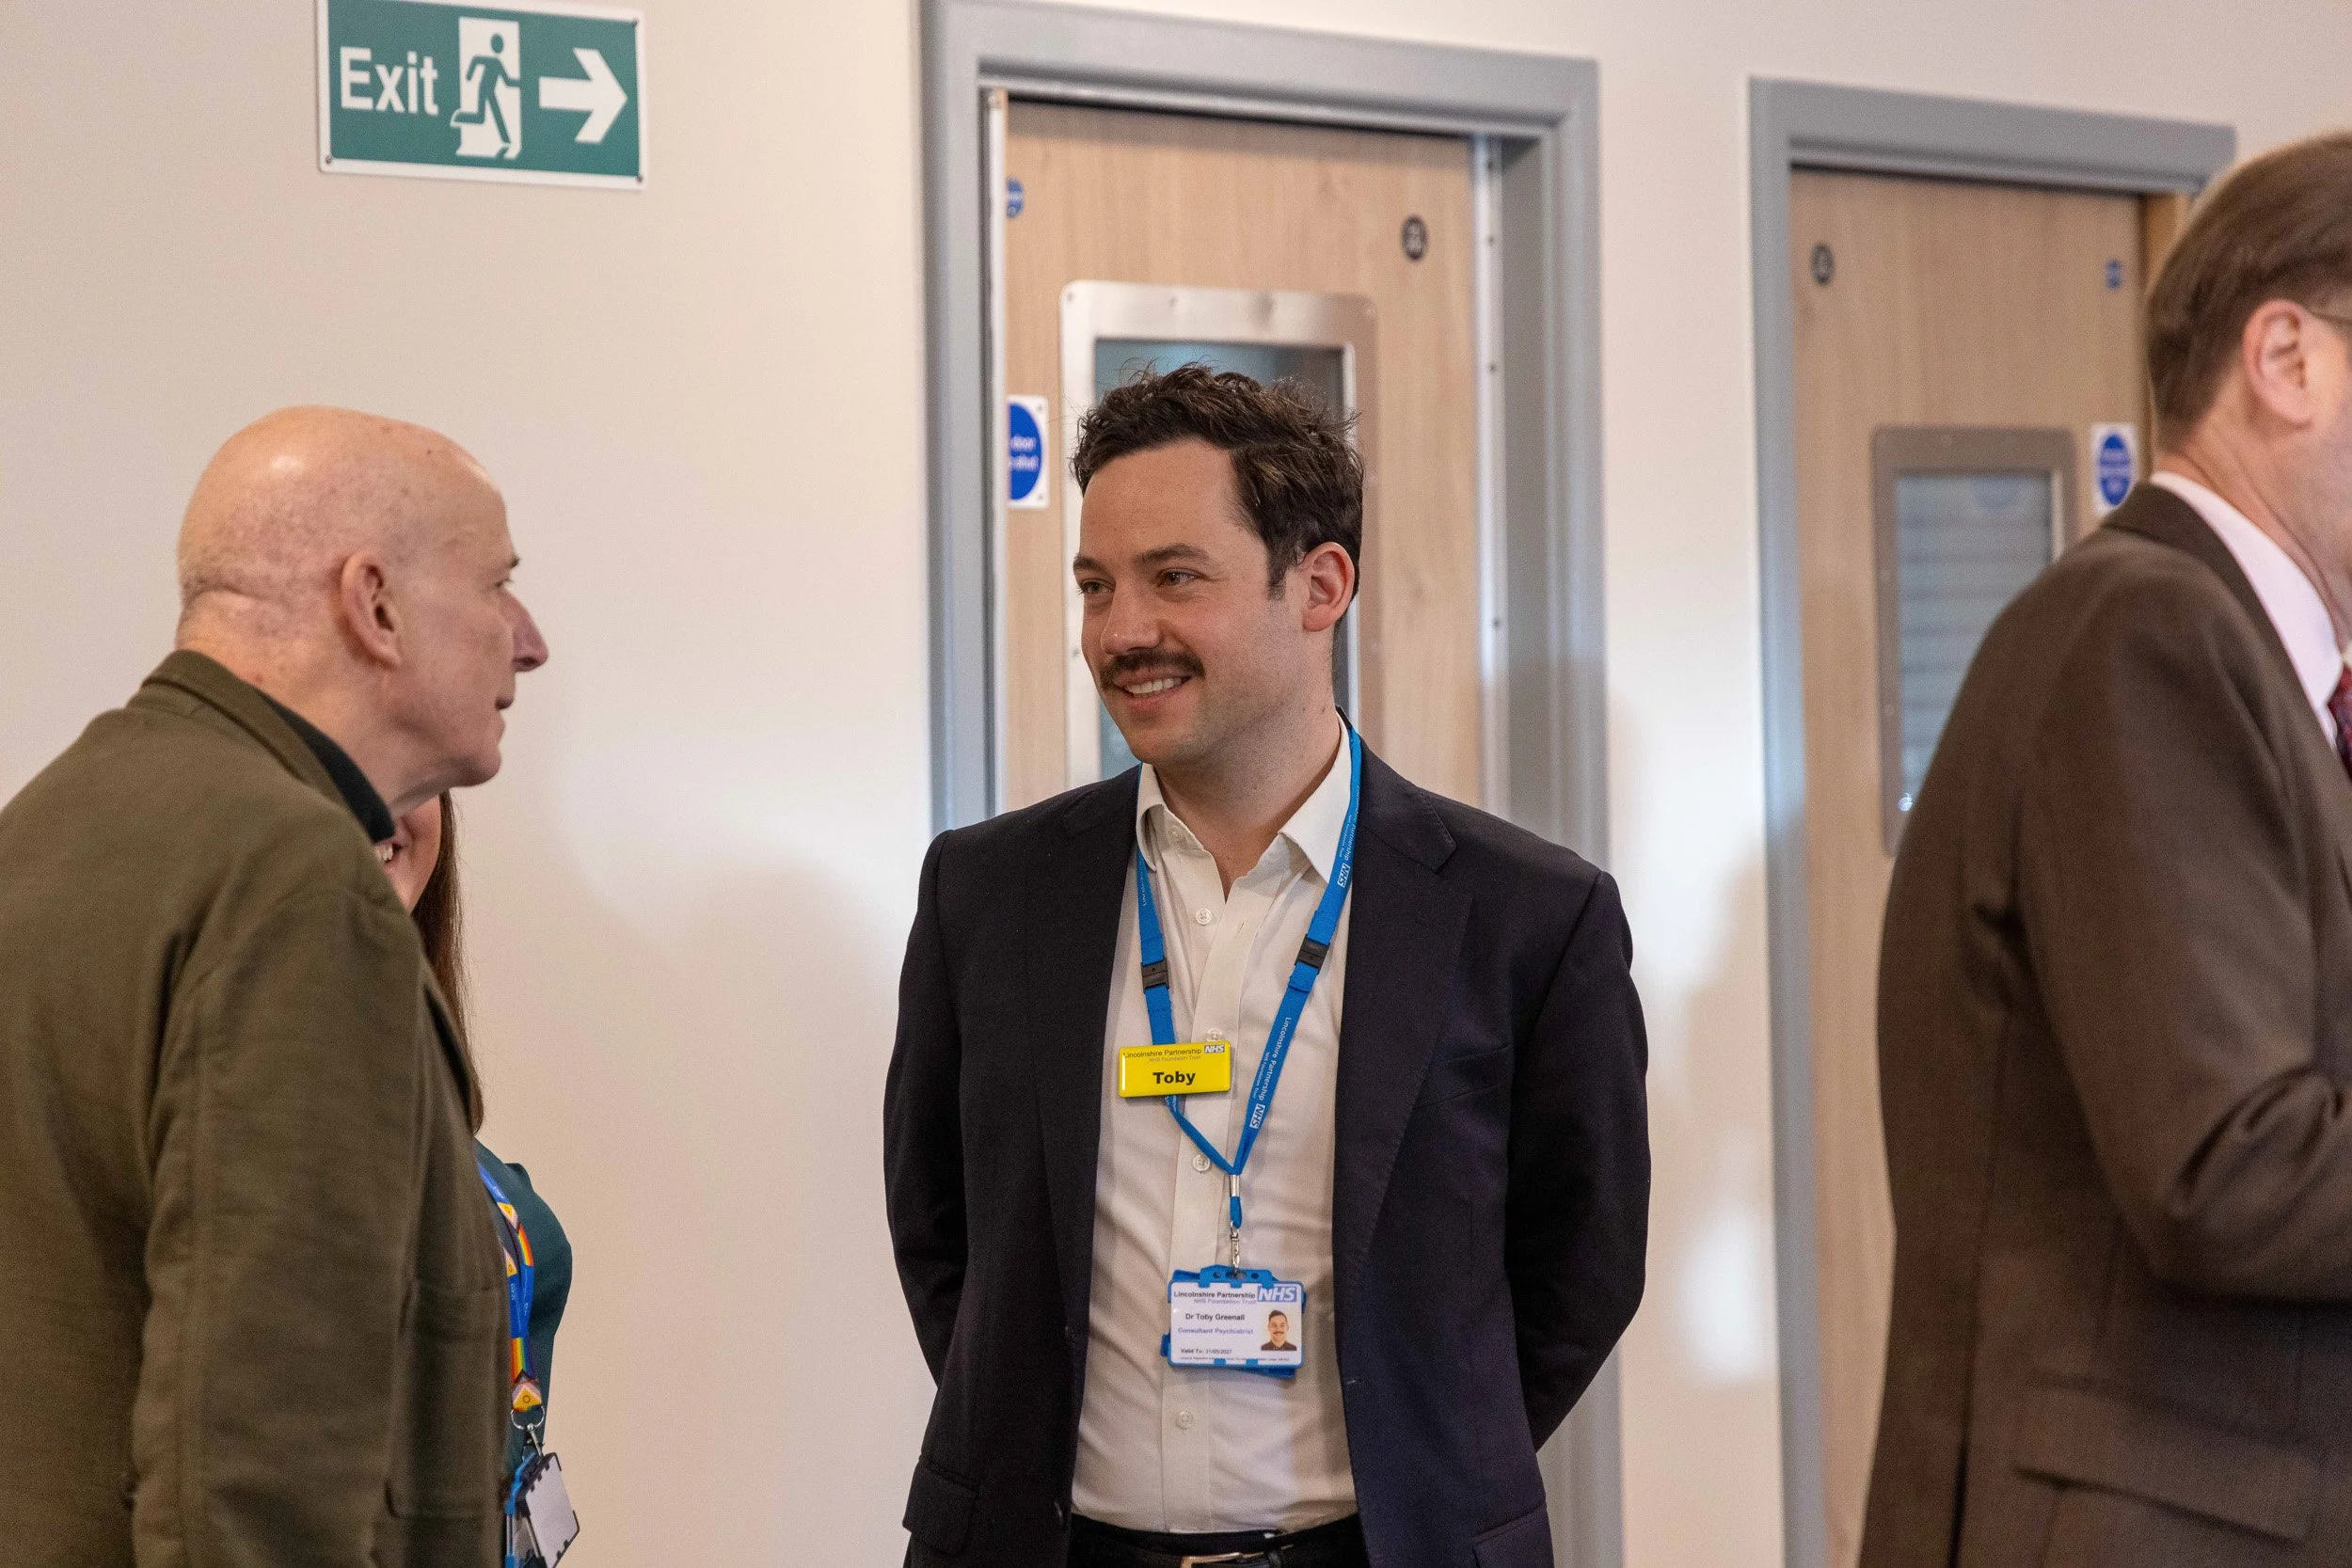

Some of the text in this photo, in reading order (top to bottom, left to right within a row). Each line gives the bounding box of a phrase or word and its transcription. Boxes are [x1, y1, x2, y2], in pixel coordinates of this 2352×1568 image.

[340, 46, 439, 116] Exit
[1343, 824, 1357, 861] Partnership
[1337, 863, 1351, 888] NHS
[1123, 1051, 1163, 1059] Lincolnshire
[1204, 1045, 1225, 1053] NHS
[1152, 1070, 1196, 1085] Toby
[1249, 1017, 1292, 1129] Lincolnshire Partnership NHS
[1258, 1286, 1296, 1302] NHS
[1196, 1313, 1214, 1322] Toby
